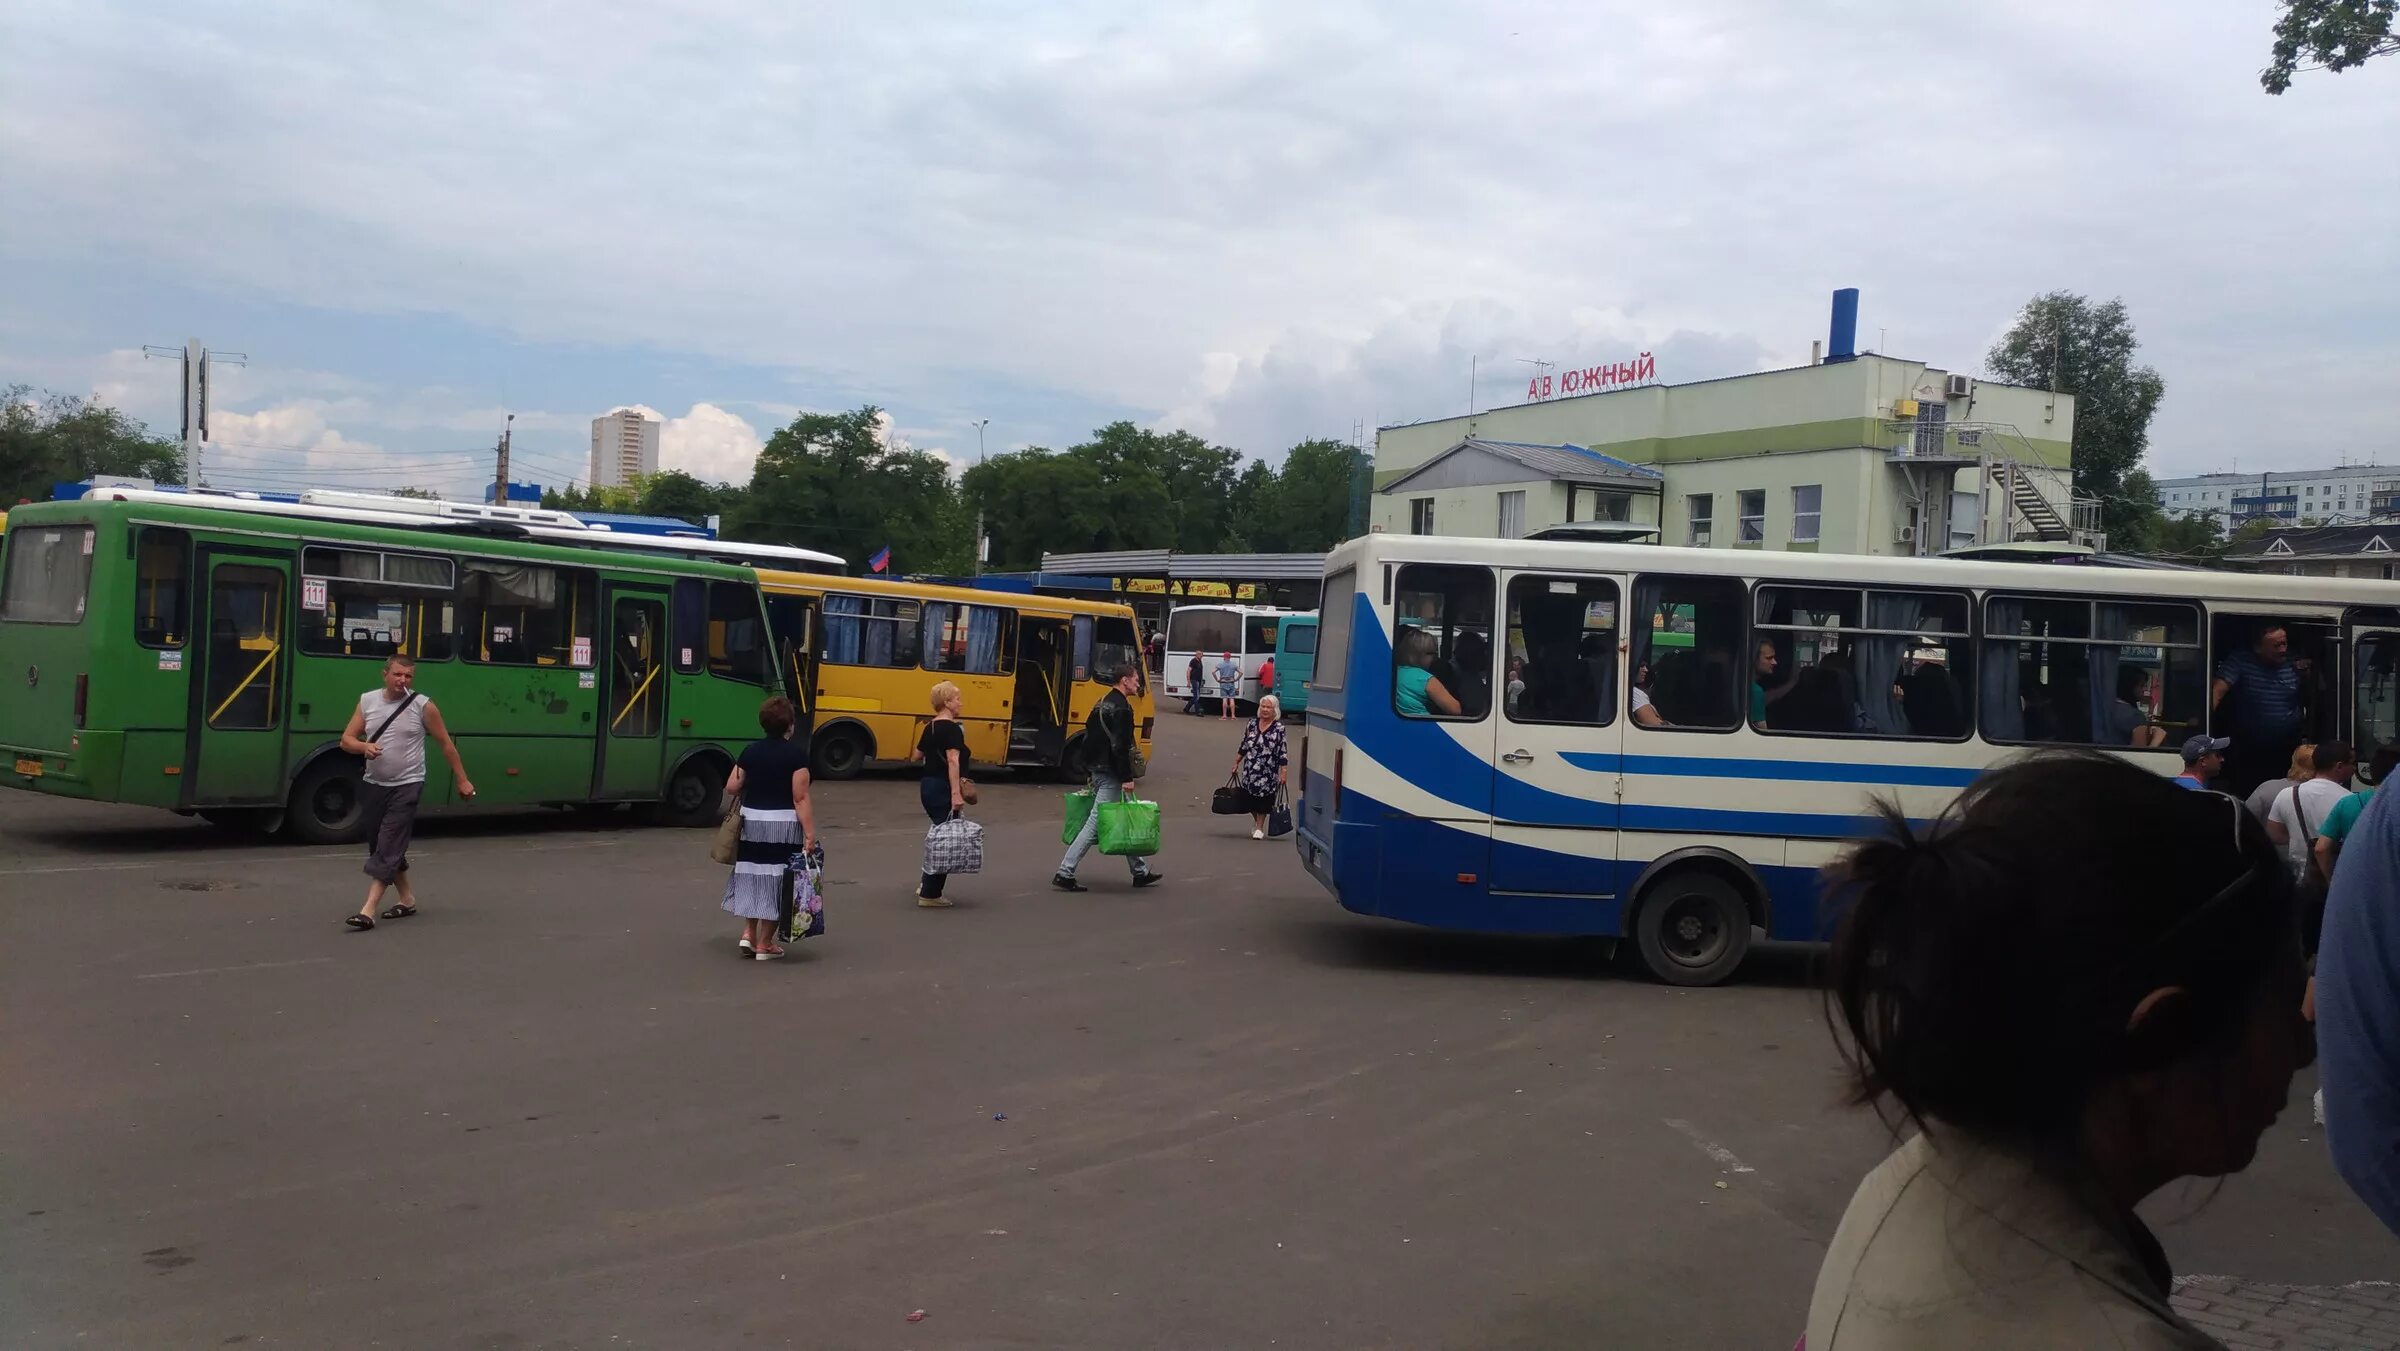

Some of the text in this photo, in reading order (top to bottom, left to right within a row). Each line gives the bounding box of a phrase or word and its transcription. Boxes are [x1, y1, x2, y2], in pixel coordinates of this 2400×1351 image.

[1527, 352, 1654, 399] АВ ЮЖНЫЙ
[305, 586, 324, 602] 111
[1217, 585, 1249, 595] ШАШЫК
[574, 648, 589, 662] 111
